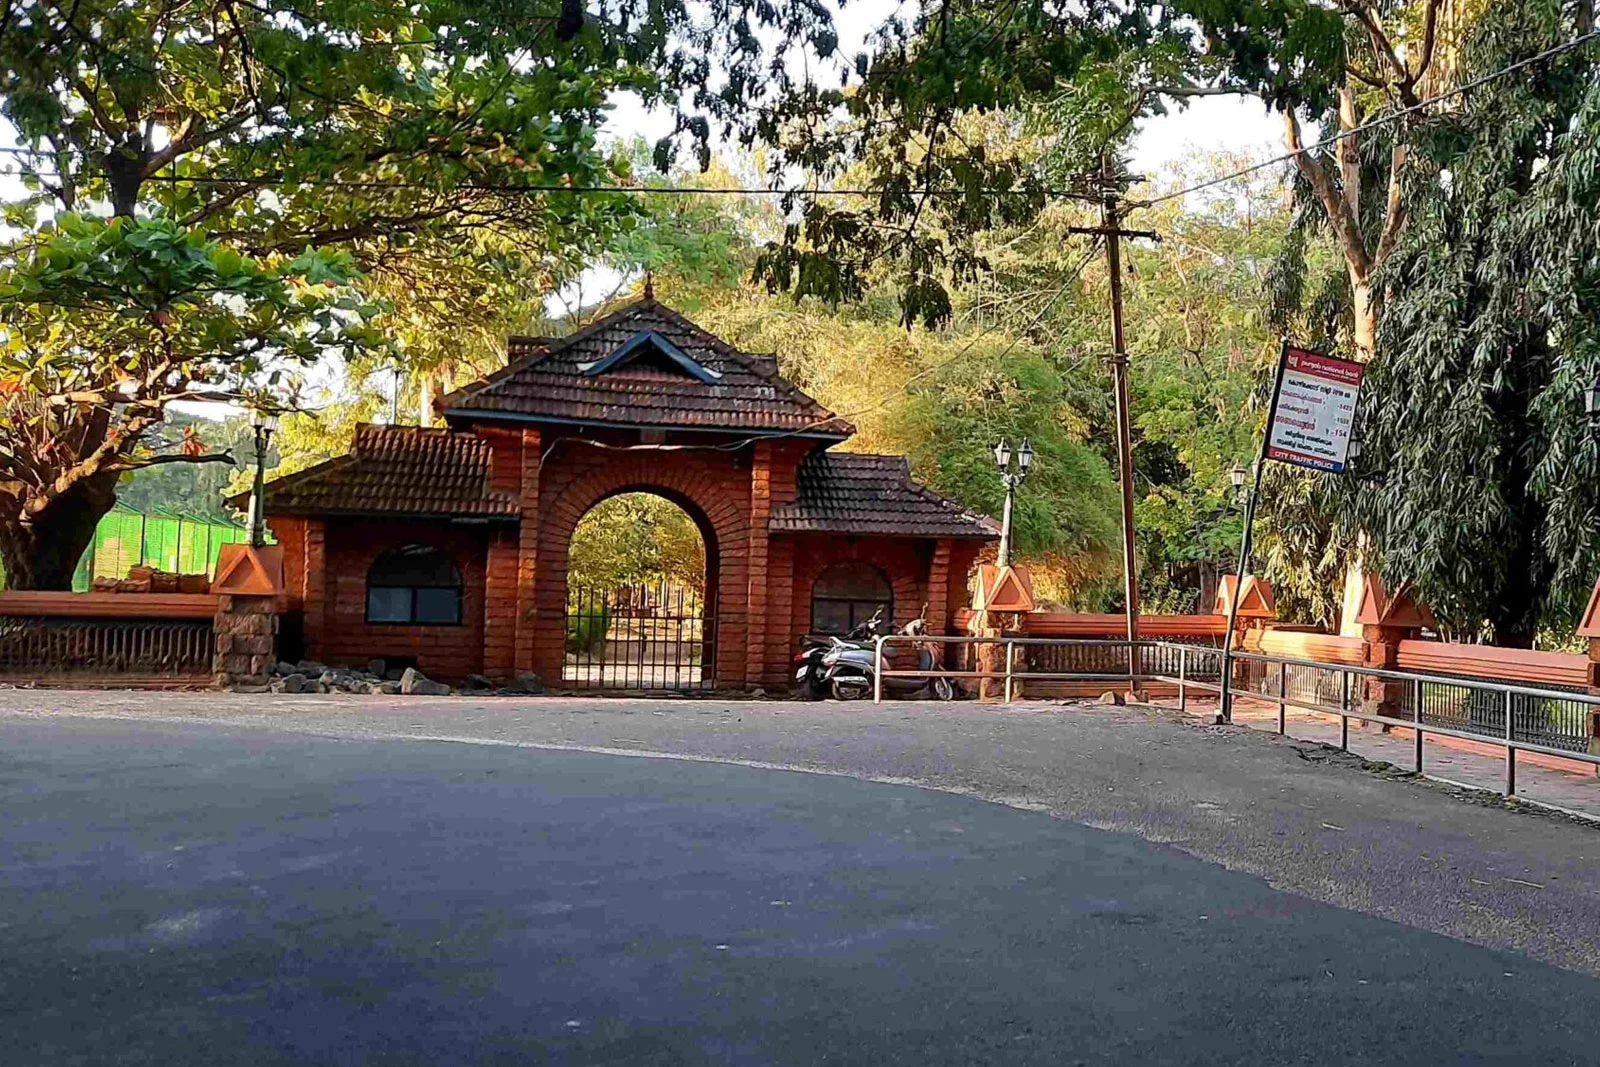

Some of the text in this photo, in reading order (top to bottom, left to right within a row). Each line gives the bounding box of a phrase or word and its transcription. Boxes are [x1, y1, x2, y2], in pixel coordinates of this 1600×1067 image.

[1301, 360, 1321, 370] punjab
[1322, 364, 1344, 374] national
[1345, 369, 1359, 378] bank
[1274, 451, 1334, 470] CITY TRAFFIC POLICE
